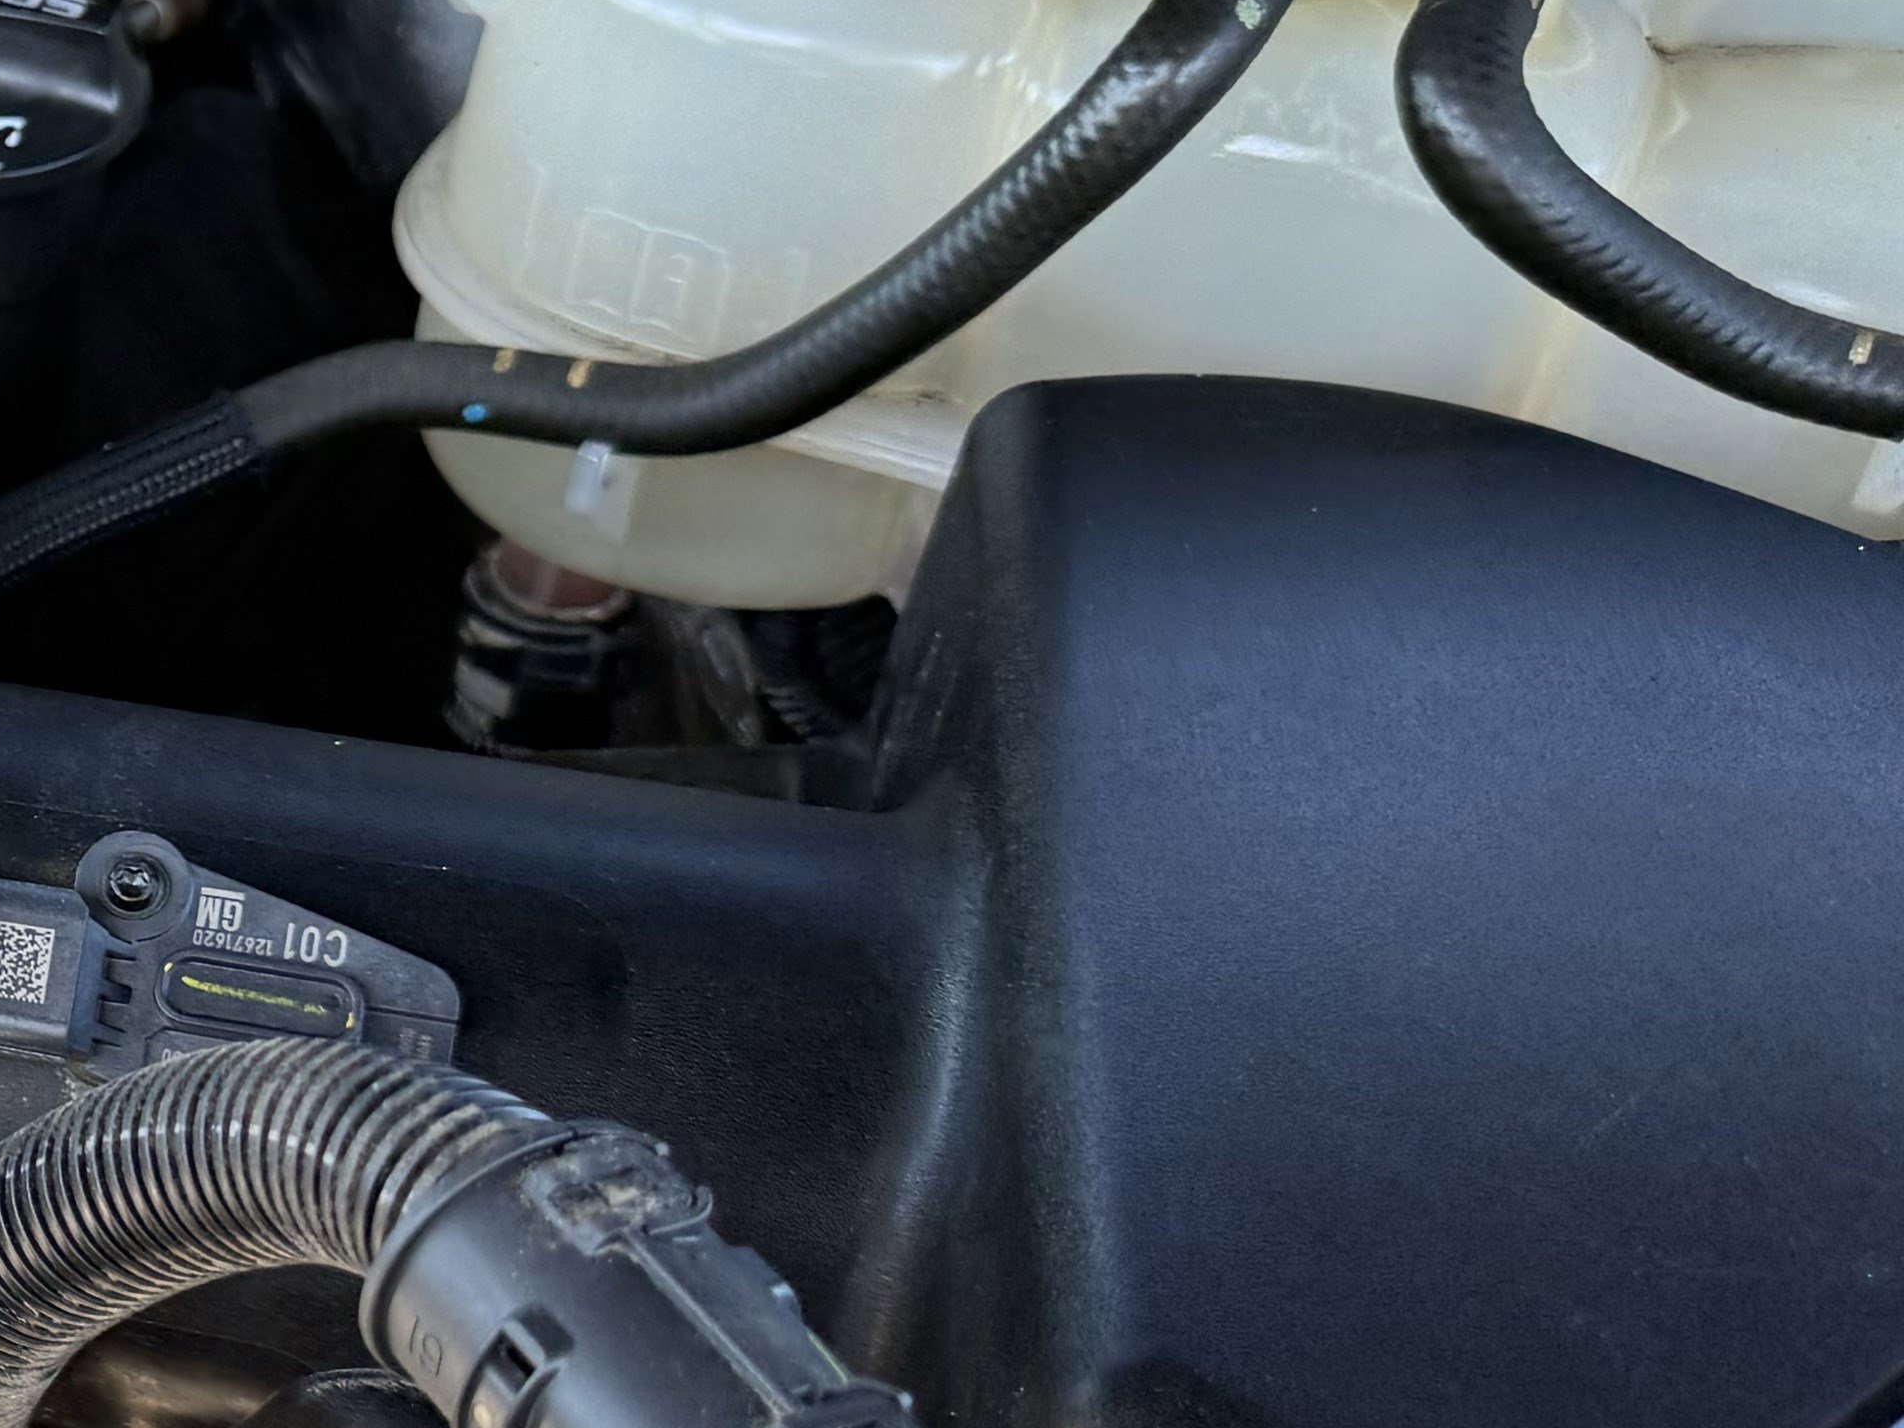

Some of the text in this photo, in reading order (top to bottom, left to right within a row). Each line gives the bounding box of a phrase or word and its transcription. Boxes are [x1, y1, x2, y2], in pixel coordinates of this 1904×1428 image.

[196, 891, 244, 932] GM
[193, 923, 347, 967] C01 12671620
